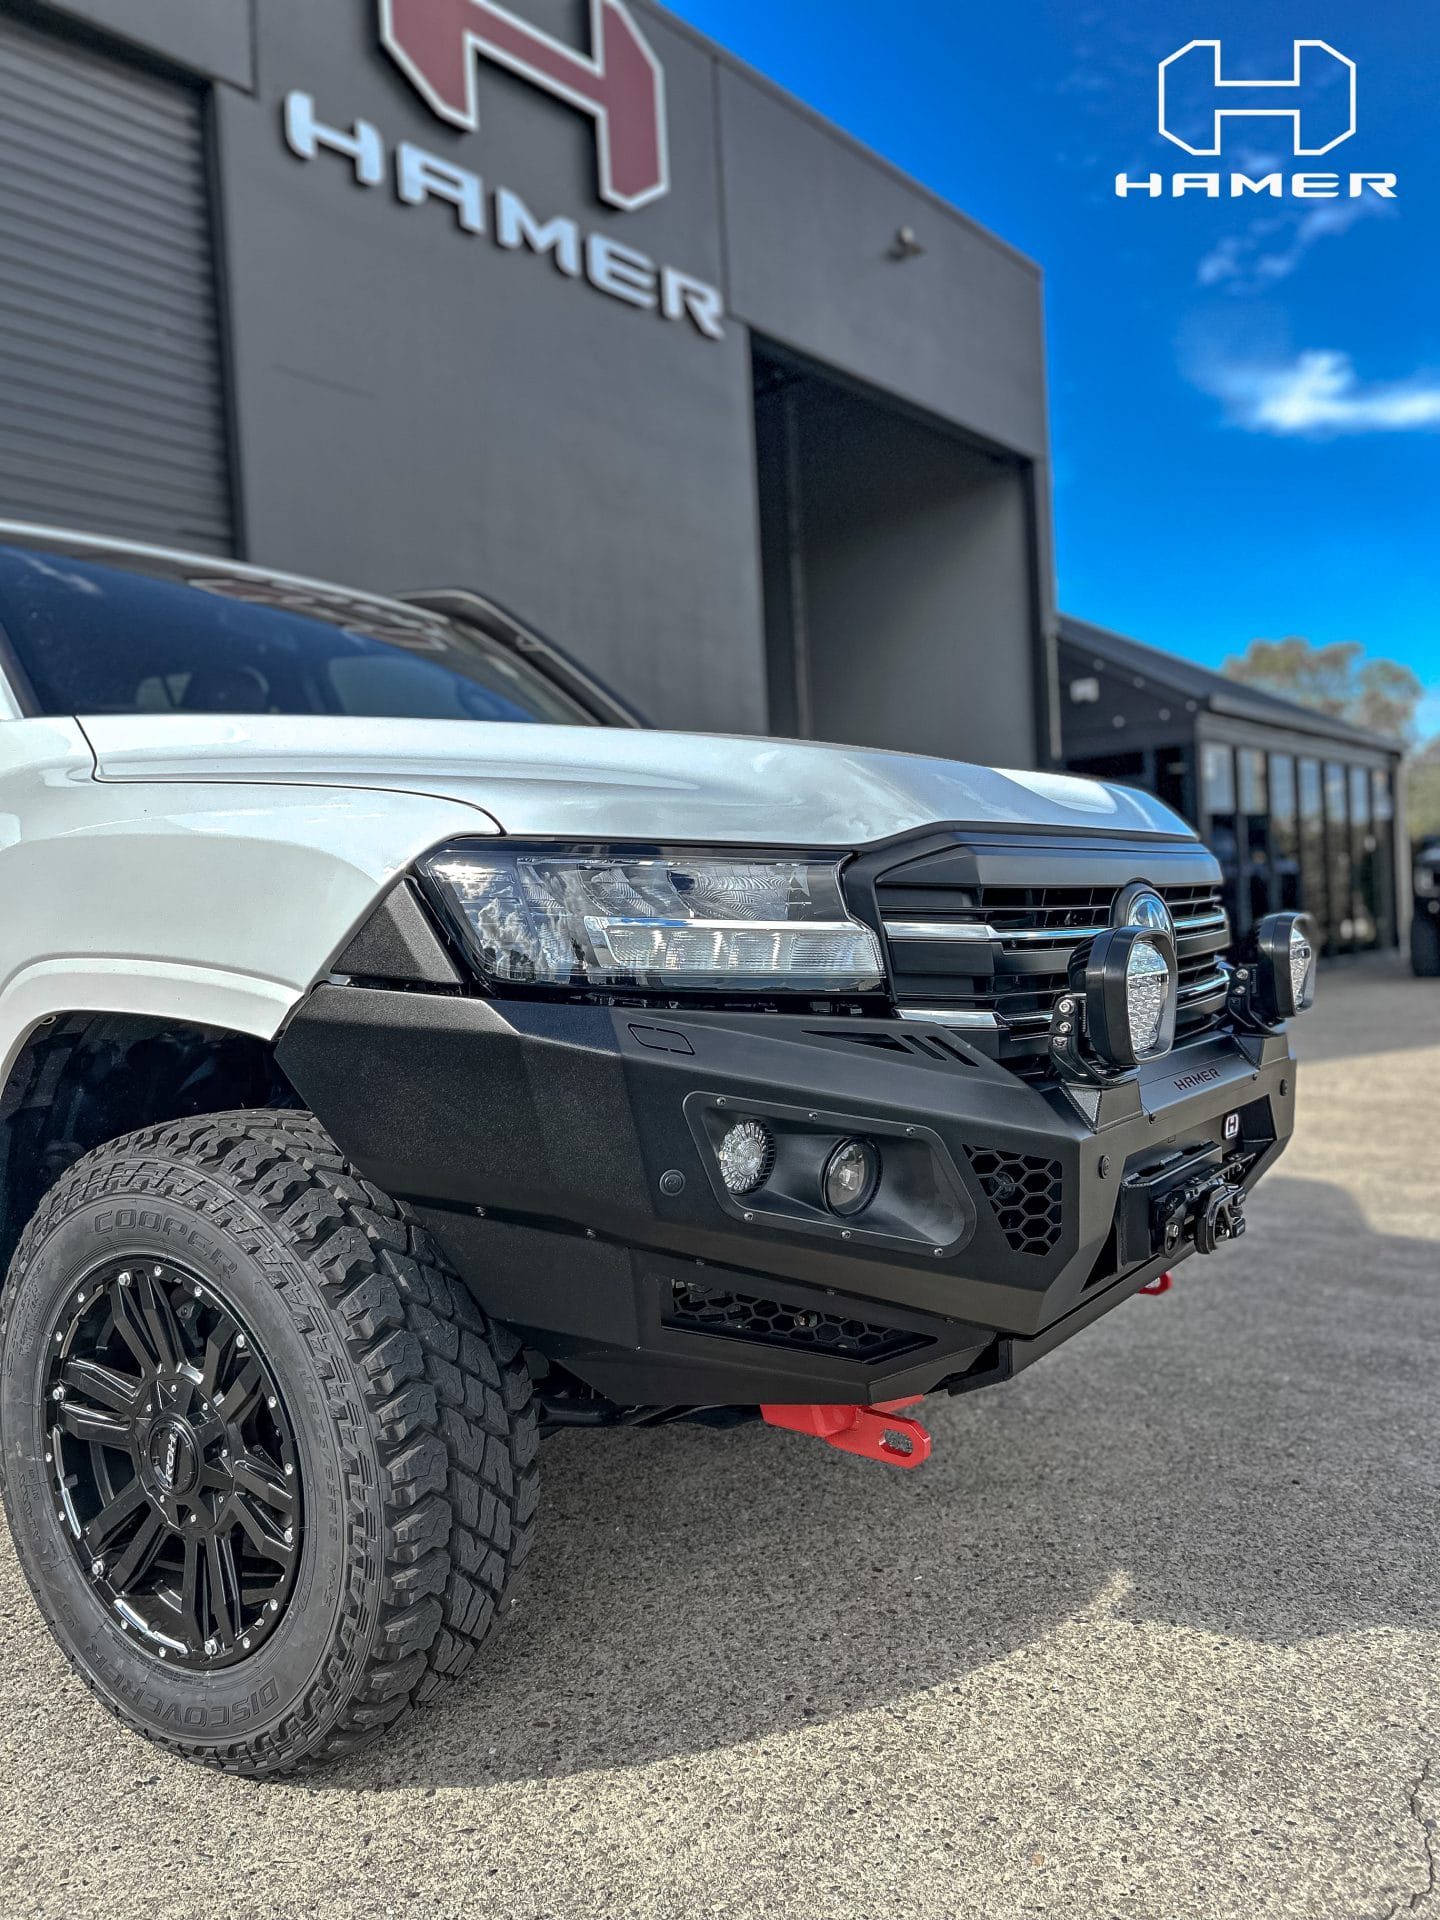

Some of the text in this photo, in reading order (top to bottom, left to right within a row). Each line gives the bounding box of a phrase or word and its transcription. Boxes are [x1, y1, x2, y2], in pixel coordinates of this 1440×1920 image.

[285, 90, 725, 341] HAMER
[1174, 1067, 1221, 1091] HAMER
[94, 1208, 238, 1280] COOPER
[83, 1641, 280, 1728] DISCOVERER
